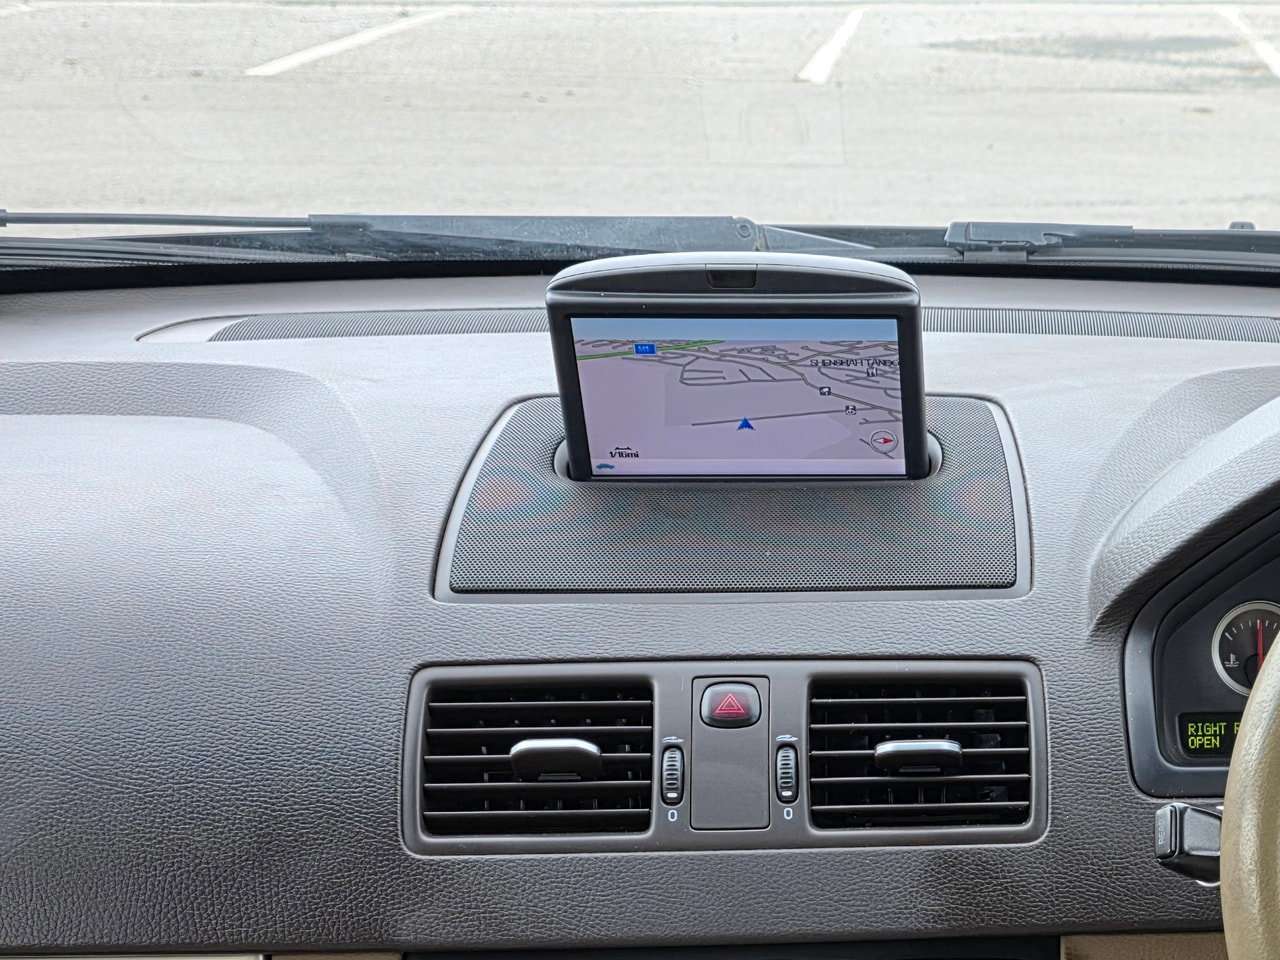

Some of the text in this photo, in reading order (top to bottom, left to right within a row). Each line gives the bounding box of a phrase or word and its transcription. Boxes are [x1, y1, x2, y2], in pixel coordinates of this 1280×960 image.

[1188, 722, 1227, 735] RIGHT
[1188, 736, 1220, 749] OPEN
[667, 809, 678, 822] 0
[783, 807, 793, 820] 0
